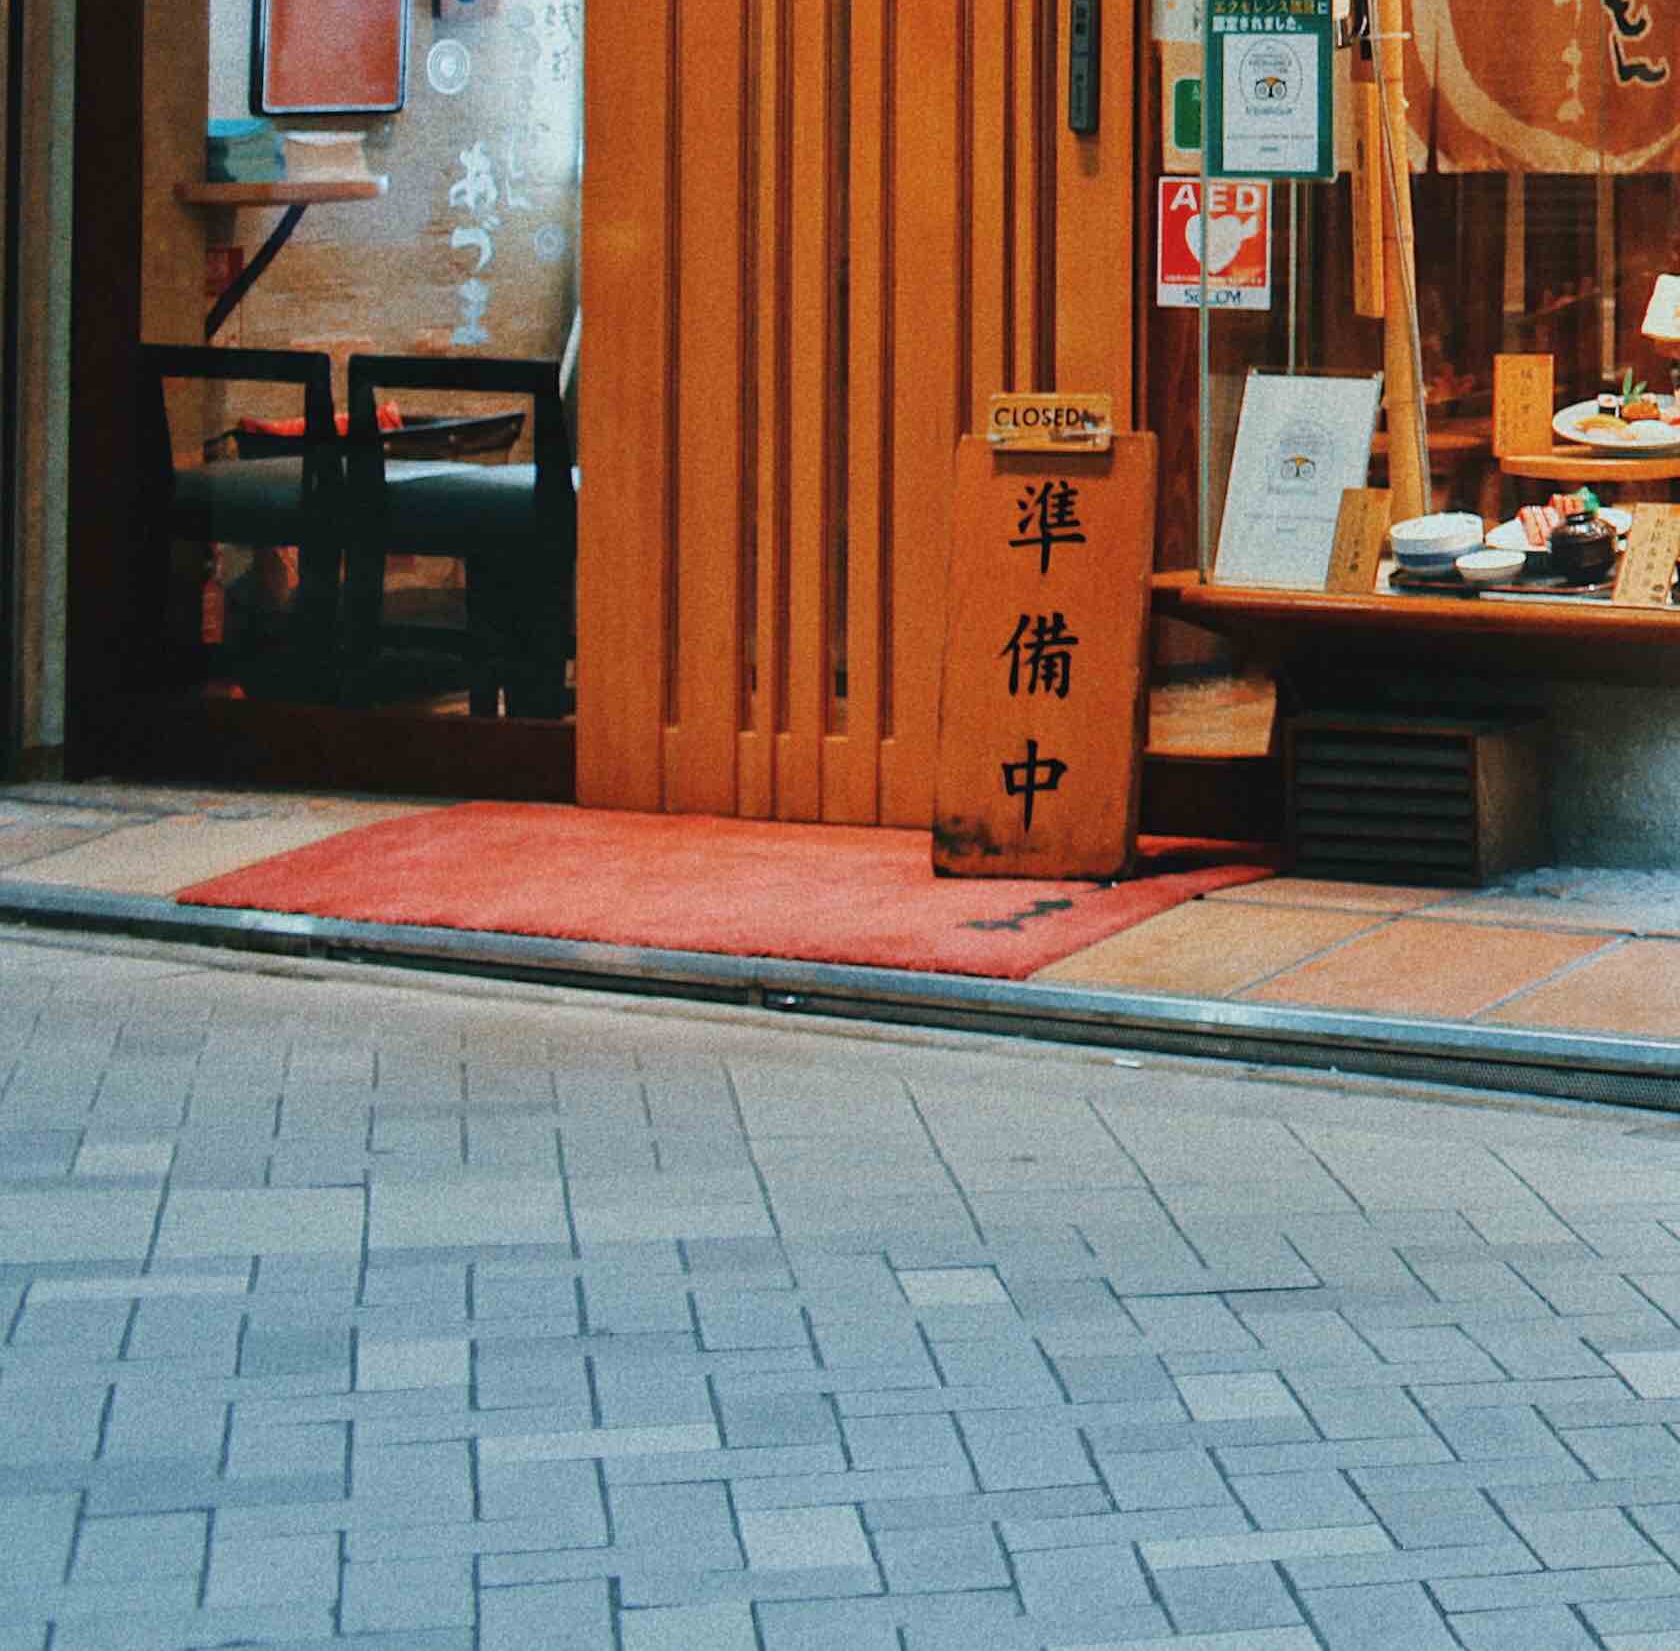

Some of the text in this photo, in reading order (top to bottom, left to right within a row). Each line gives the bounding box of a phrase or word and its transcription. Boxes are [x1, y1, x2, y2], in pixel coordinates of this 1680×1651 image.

[1169, 184, 1262, 212] AED
[994, 406, 1081, 429] CLOSED
[1000, 480, 1088, 833] 準備中
